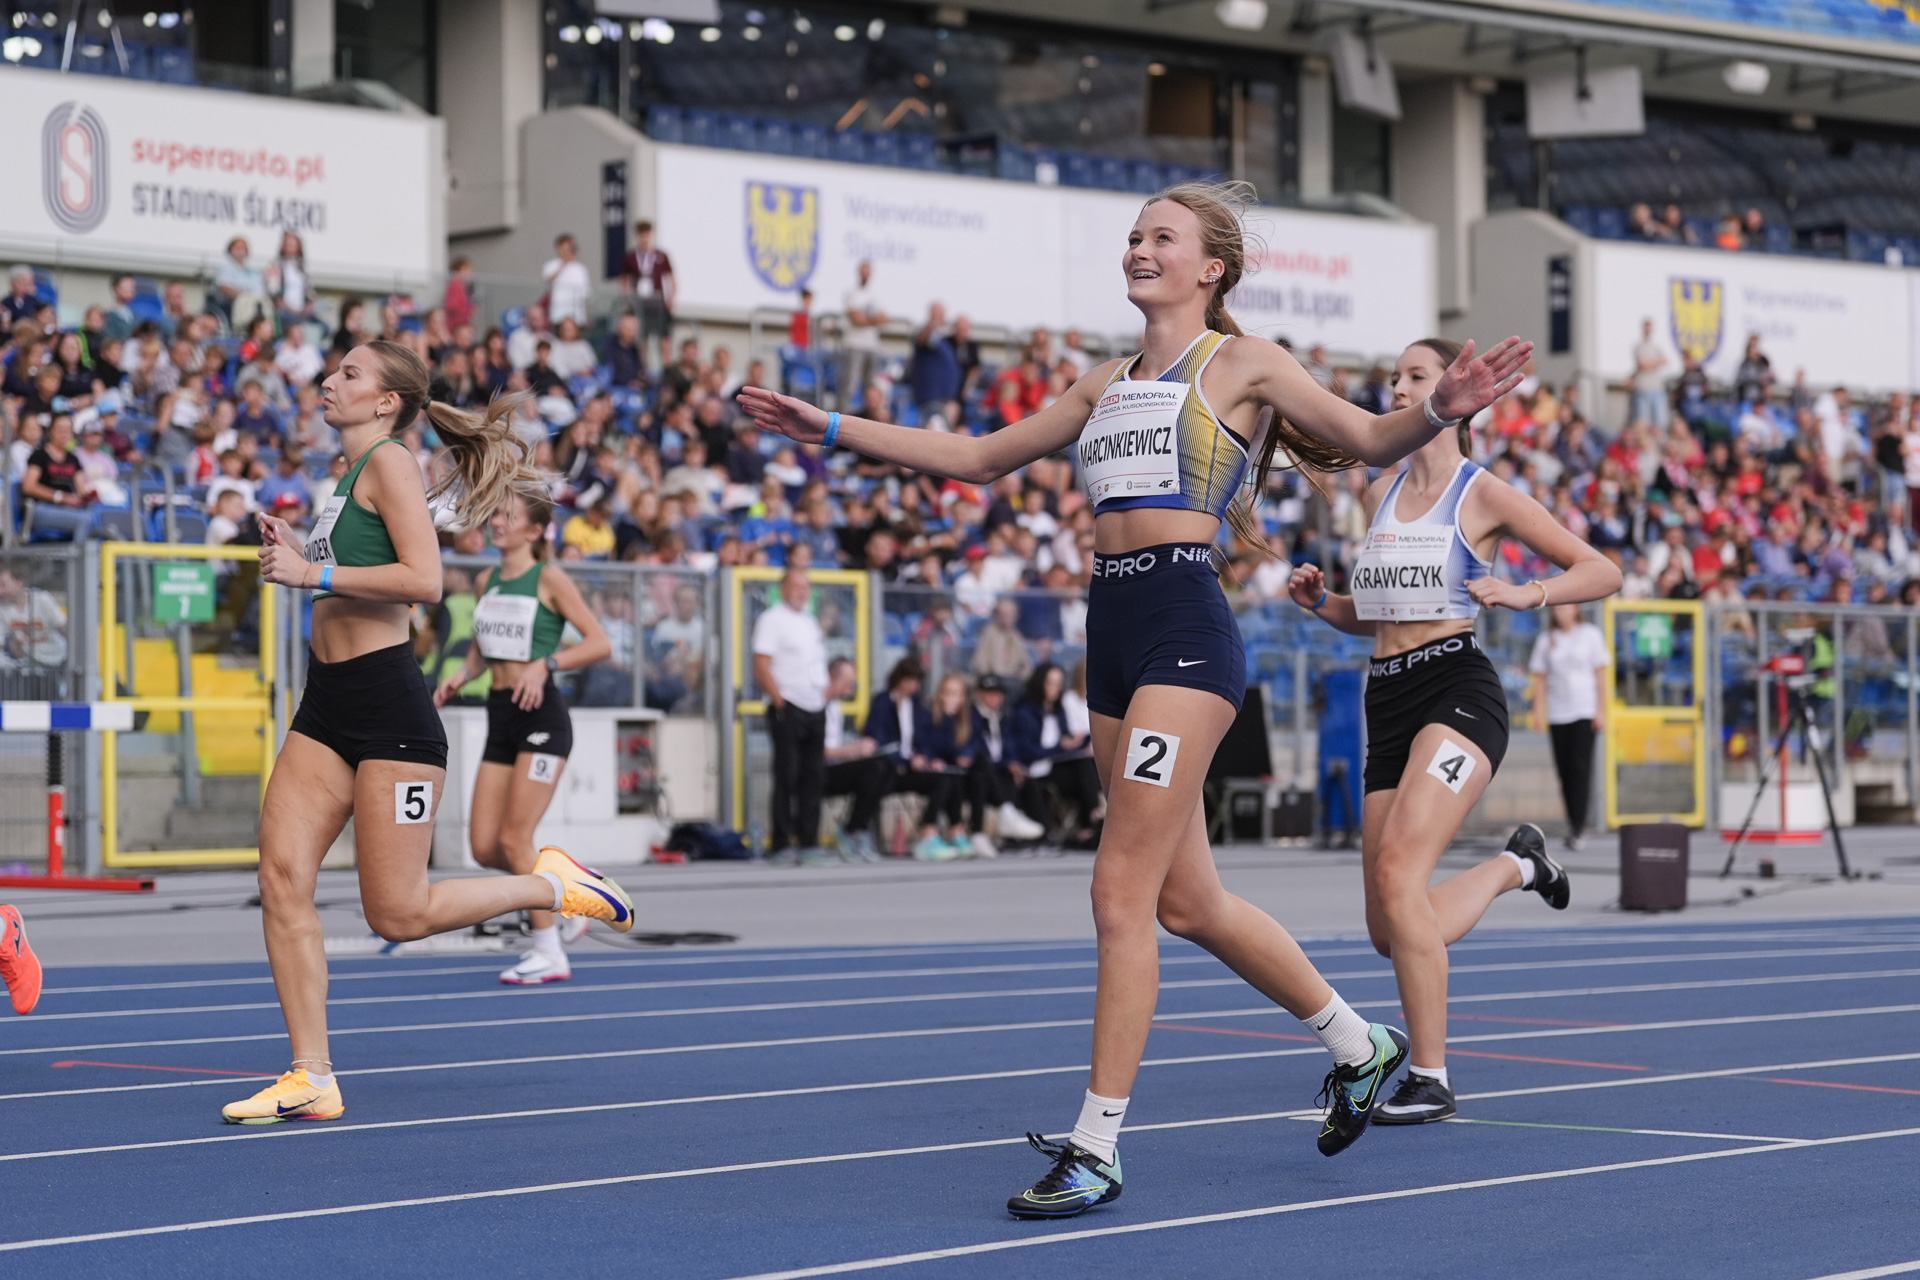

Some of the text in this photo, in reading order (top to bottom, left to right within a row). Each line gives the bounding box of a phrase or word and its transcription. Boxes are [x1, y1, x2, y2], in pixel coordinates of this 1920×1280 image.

[132, 139, 326, 189] superauto.pl
[132, 181, 239, 223] STADION
[1122, 392, 1178, 402] MEMORIAŁ
[1080, 426, 1172, 470] MARCINKIEWICZ
[1159, 479, 1173, 488] 4F
[1105, 552, 1156, 578] PRO
[1354, 565, 1444, 590] KRAWCZYK
[1369, 657, 1402, 677] NIKE
[1406, 638, 1464, 669] PRO
[1133, 736, 1168, 782] 2
[1438, 755, 1466, 784] 4
[405, 786, 425, 820] 5
